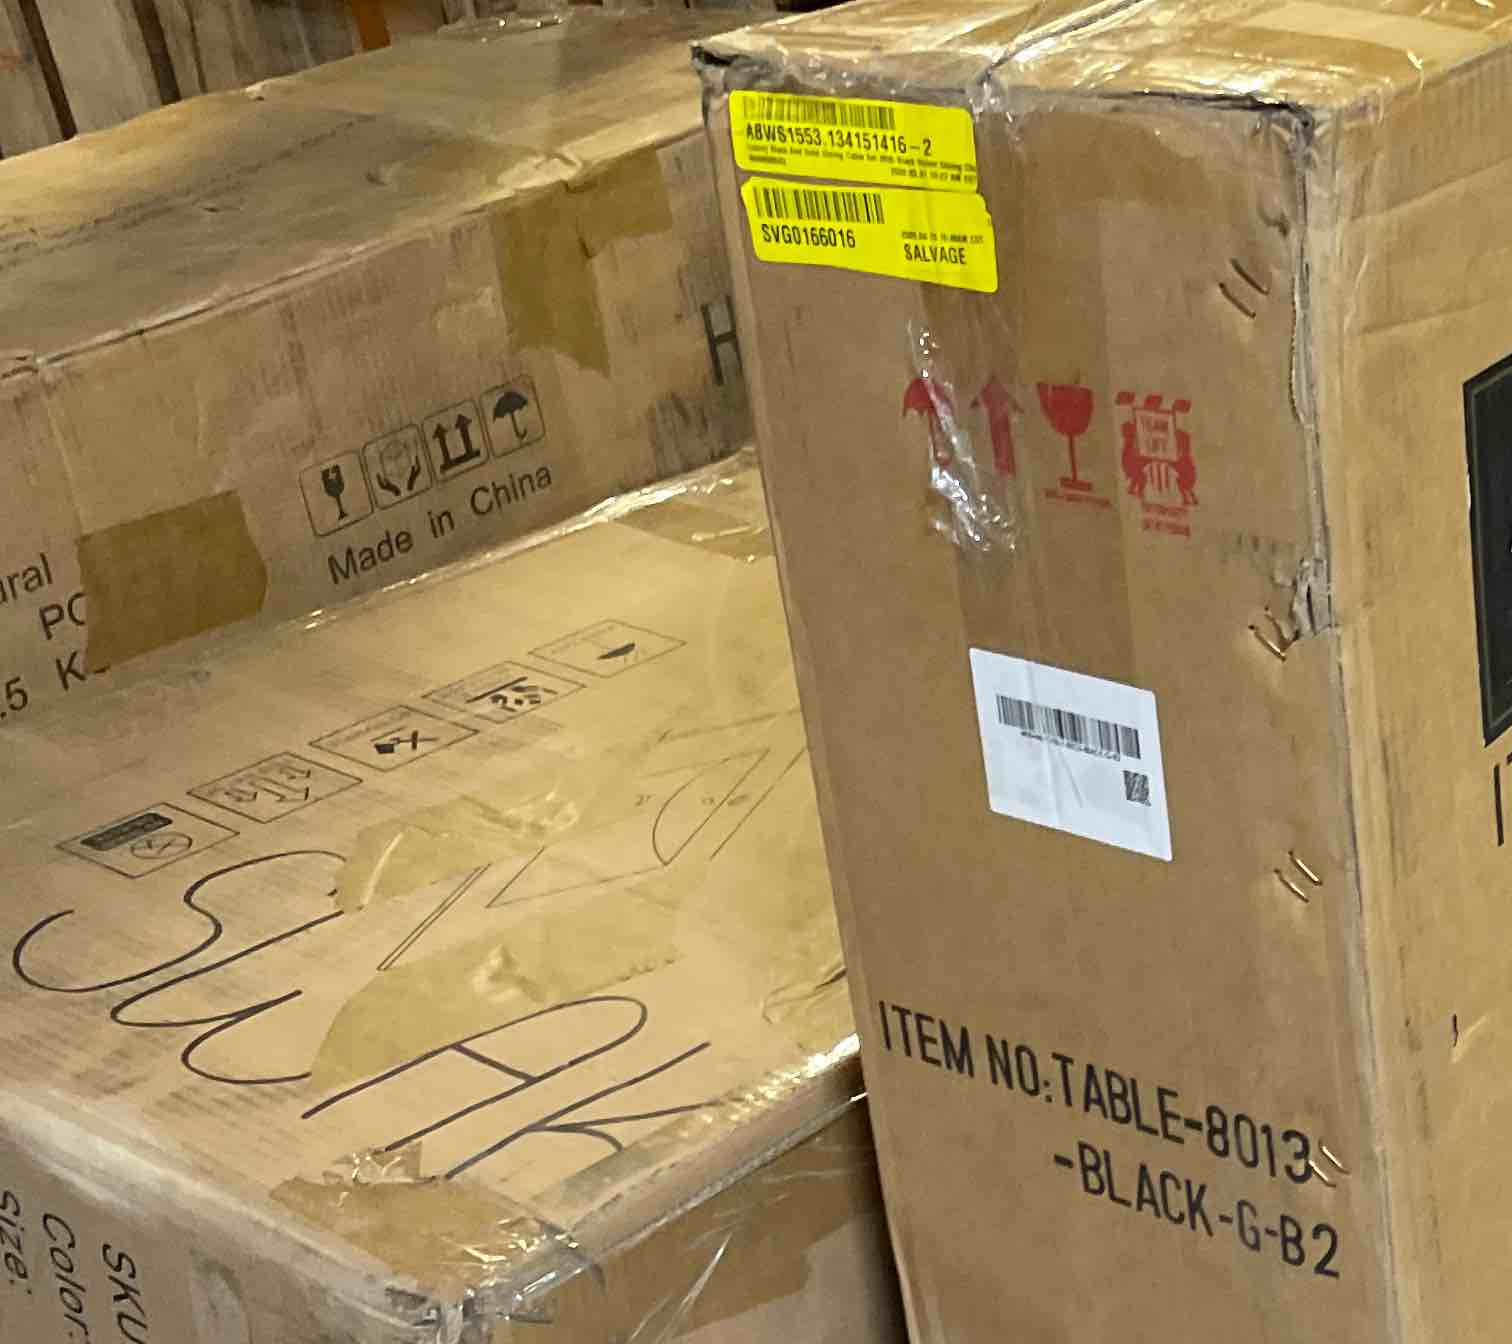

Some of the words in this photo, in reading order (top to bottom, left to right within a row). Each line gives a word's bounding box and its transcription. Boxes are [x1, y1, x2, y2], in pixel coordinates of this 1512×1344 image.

[761, 223, 856, 248] SVG0166016
[903, 244, 966, 265] SALVAGE
[327, 529, 415, 586] Made
[430, 509, 456, 539] in
[470, 461, 554, 518] China
[878, 1000, 975, 1077] ITEM
[1053, 1141, 1341, 1280] -BLACK-G-B2
